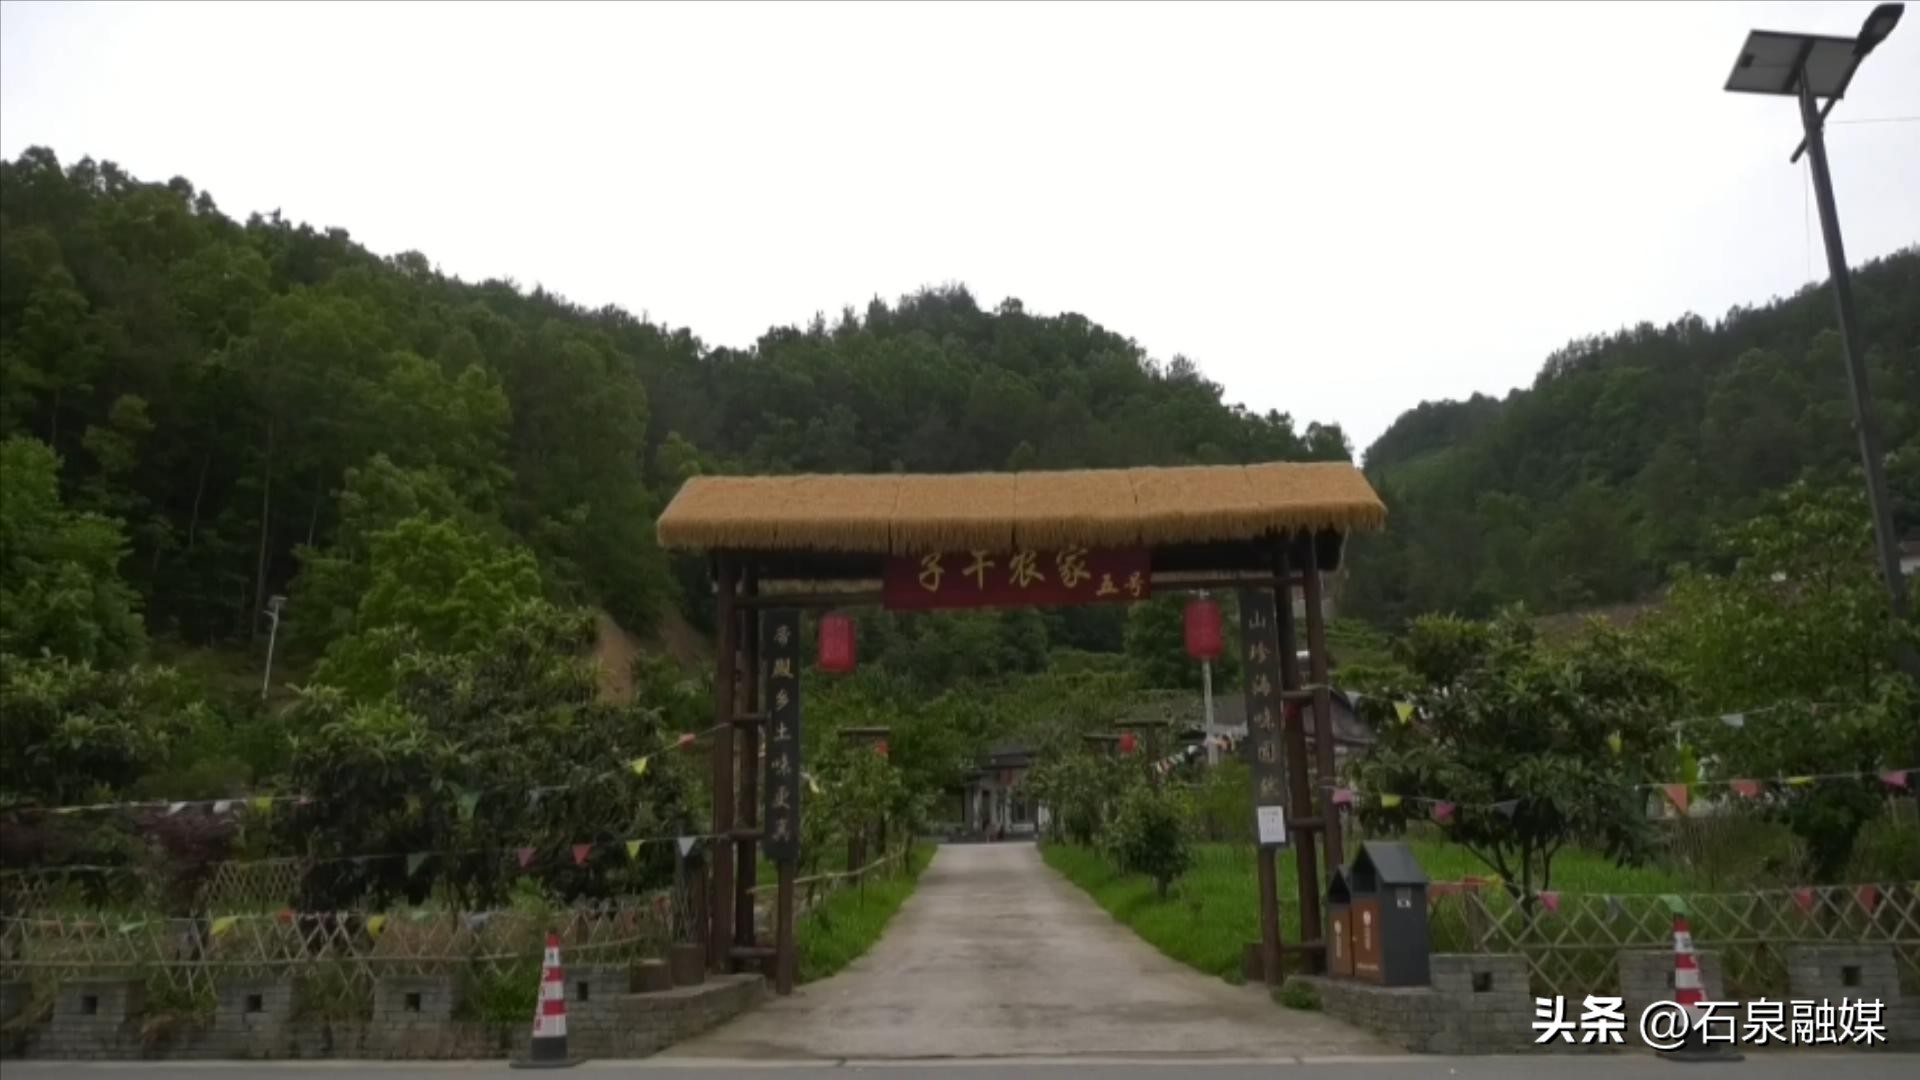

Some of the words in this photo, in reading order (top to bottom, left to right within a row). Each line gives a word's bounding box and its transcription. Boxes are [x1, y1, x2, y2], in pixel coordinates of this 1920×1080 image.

[1096, 571, 1145, 597] 五号
[1247, 608, 1281, 799] 山珍海味固然
